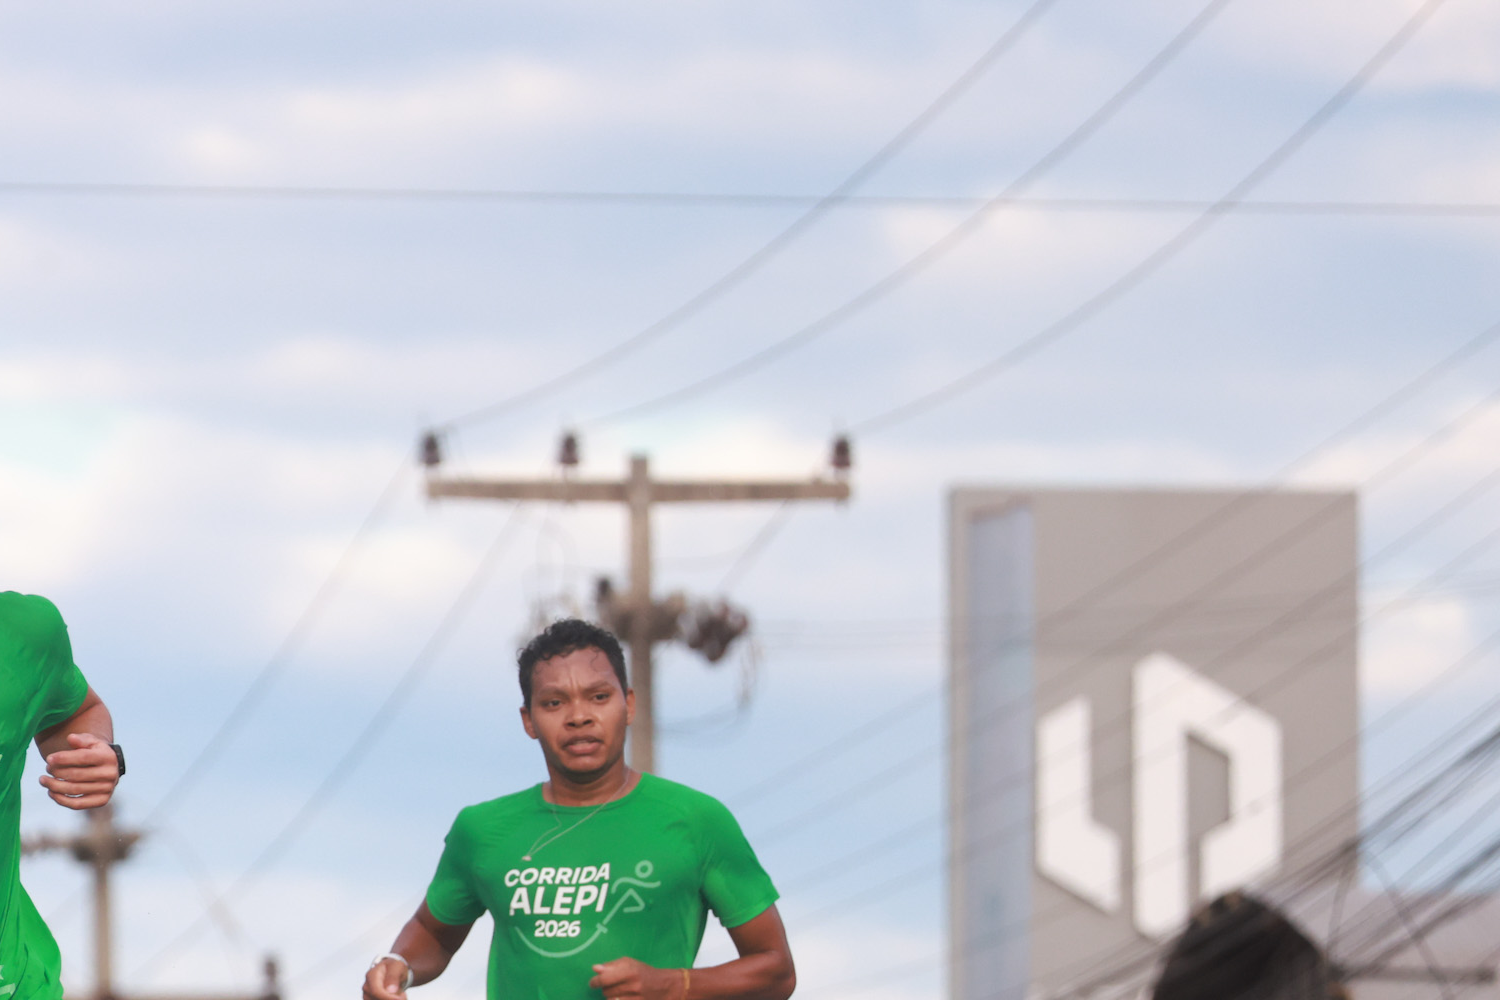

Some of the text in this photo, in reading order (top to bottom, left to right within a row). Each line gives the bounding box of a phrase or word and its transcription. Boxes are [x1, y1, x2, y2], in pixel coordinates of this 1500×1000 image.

[504, 862, 610, 887] CORRIDA
[509, 883, 609, 916] ALEPI
[534, 919, 581, 938] 2026
